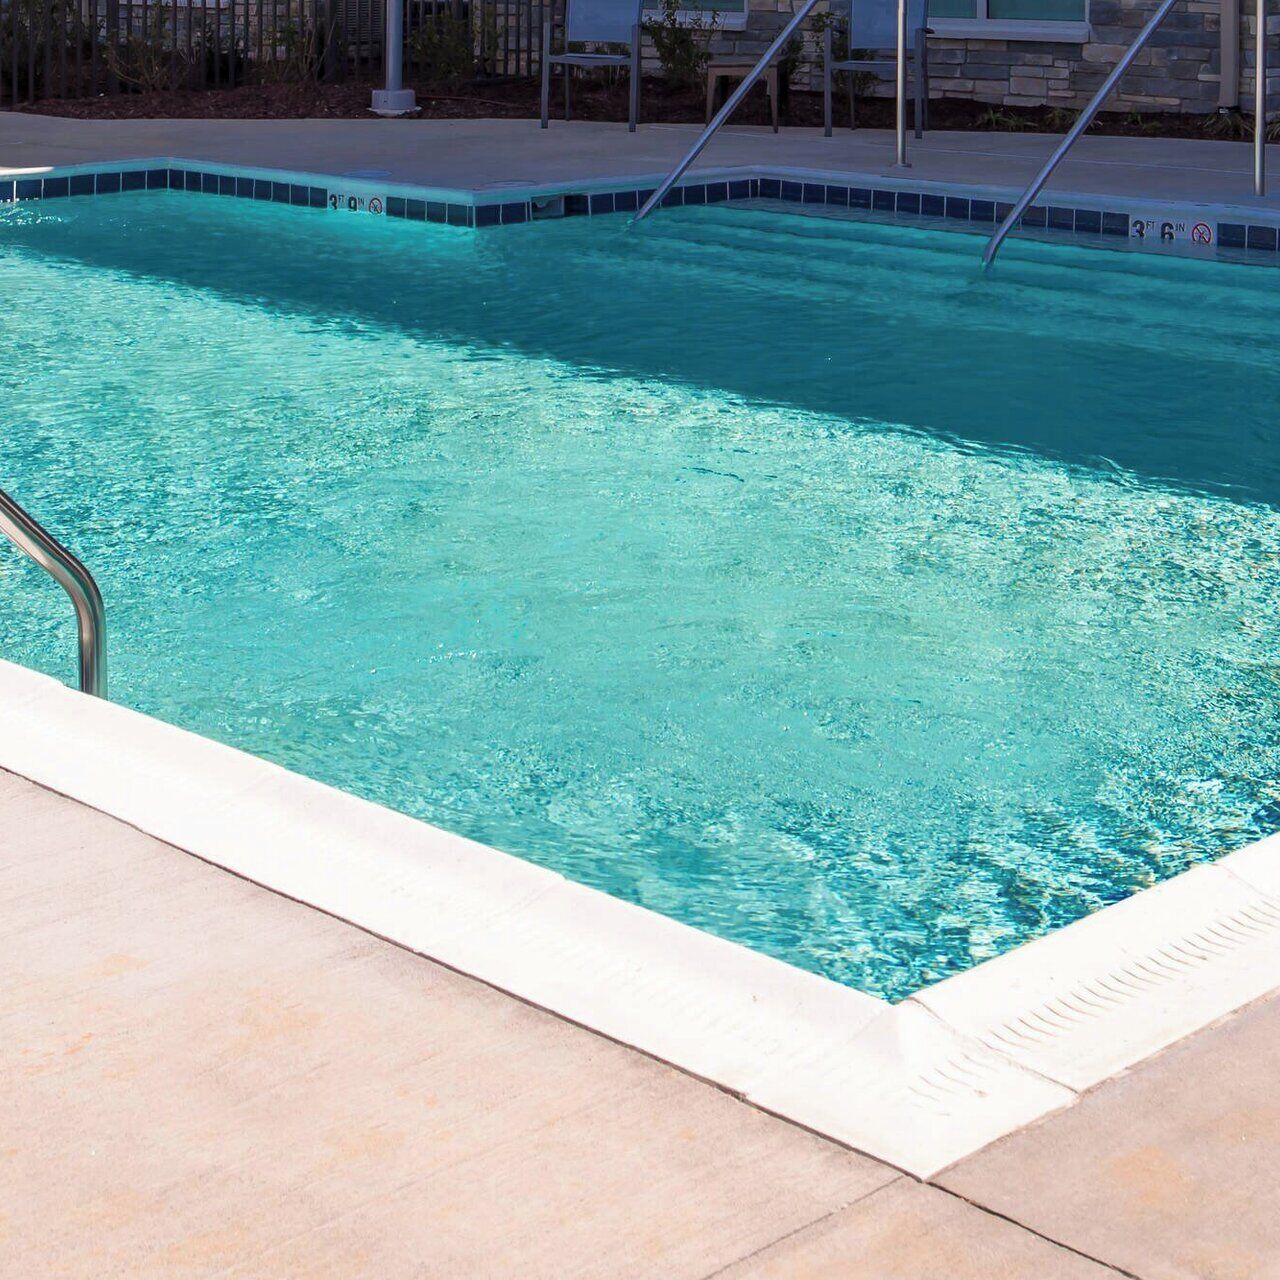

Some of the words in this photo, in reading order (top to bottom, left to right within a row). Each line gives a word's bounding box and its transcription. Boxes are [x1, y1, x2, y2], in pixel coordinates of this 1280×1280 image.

[329, 194, 338, 210] 3
[348, 196, 357, 211] 9
[1131, 220, 1145, 239] 3
[1146, 221, 1155, 230] FT
[1161, 222, 1175, 240] 6
[1175, 223, 1185, 232] IN
